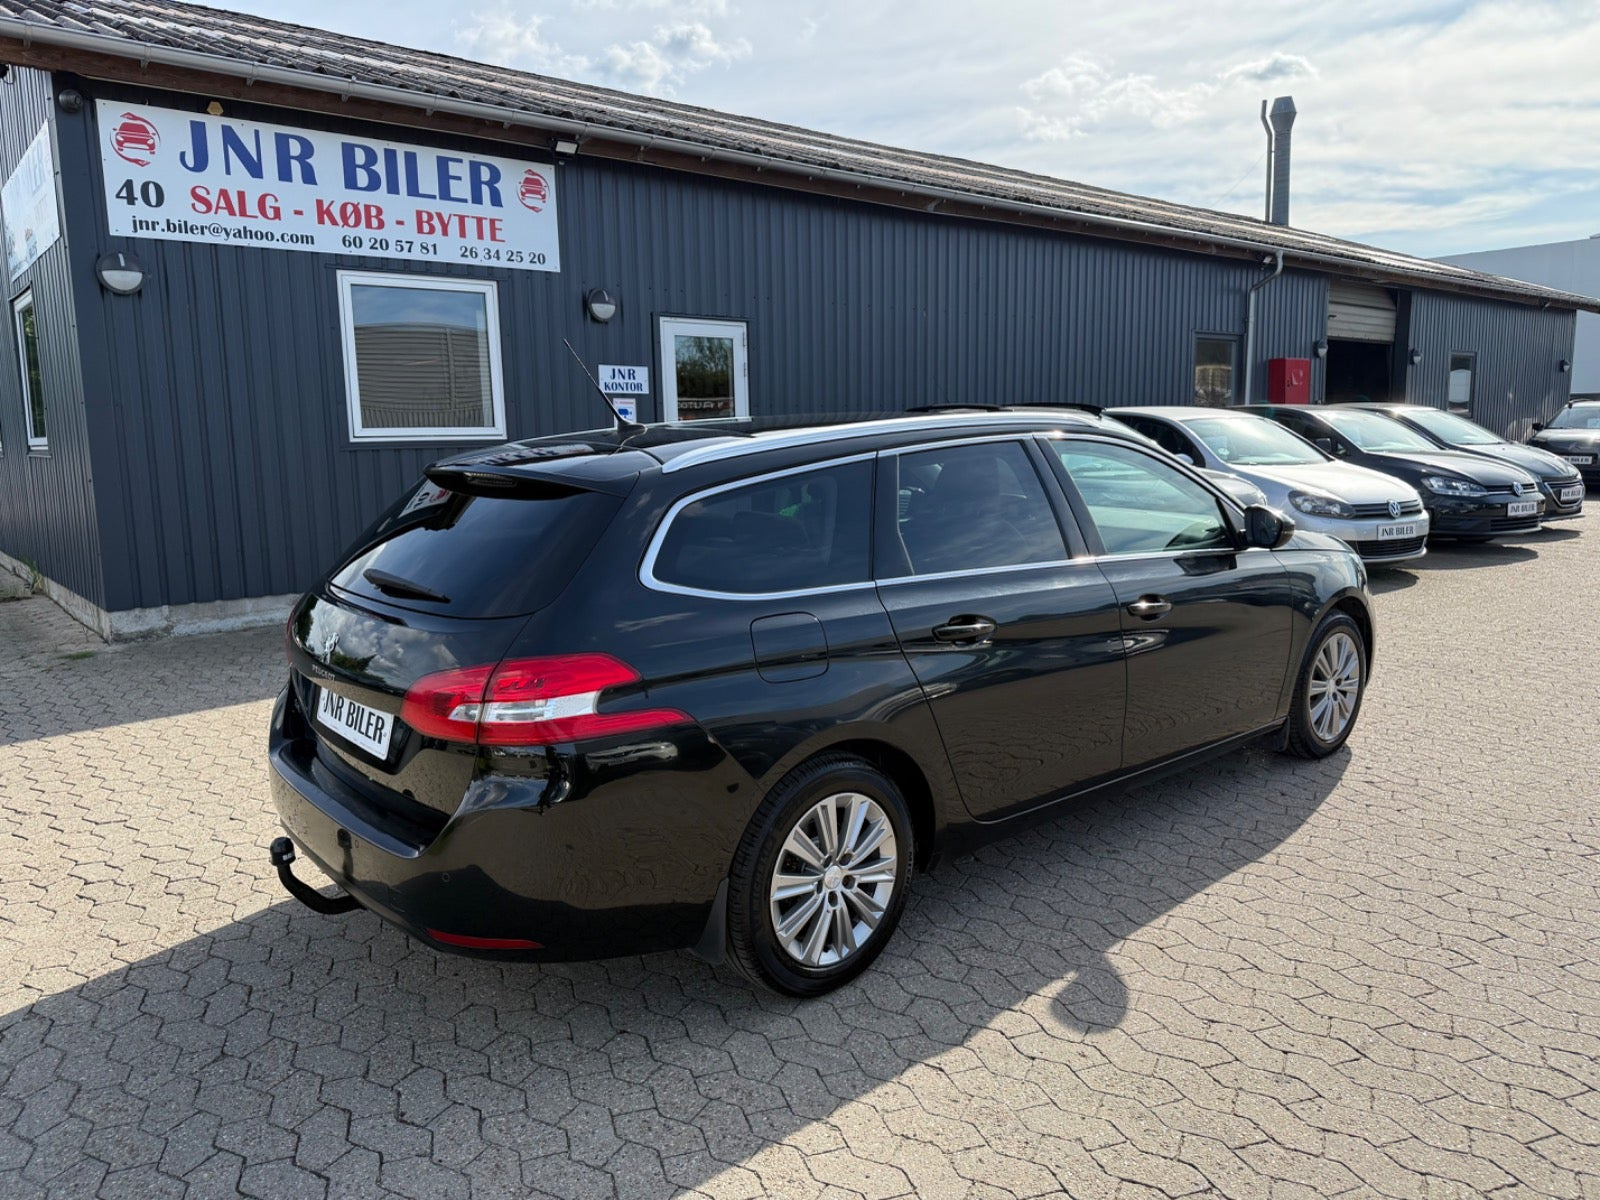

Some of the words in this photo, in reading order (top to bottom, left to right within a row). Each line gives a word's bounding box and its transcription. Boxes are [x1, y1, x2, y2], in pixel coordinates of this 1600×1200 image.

[179, 120, 318, 185] JNR
[341, 141, 503, 208] BILER
[115, 179, 165, 208] 40
[190, 185, 282, 221] SALG
[315, 198, 385, 231] KØB
[415, 209, 506, 243] BYTTE
[132, 215, 315, 245] jnr.biler@yahoo.com
[341, 234, 363, 249] 60
[368, 237, 390, 251] 20
[395, 240, 414, 253] 57
[420, 242, 438, 255] 81
[459, 245, 478, 259] 26
[483, 248, 500, 261] 34
[506, 250, 524, 263] 25
[528, 252, 546, 265] 20
[604, 381, 643, 391] KONTOR
[610, 368, 636, 380] JNR
[1382, 527, 1394, 537] JNR
[1396, 526, 1414, 536] BILER
[323, 690, 345, 722] JNR
[345, 701, 385, 744] BILER
